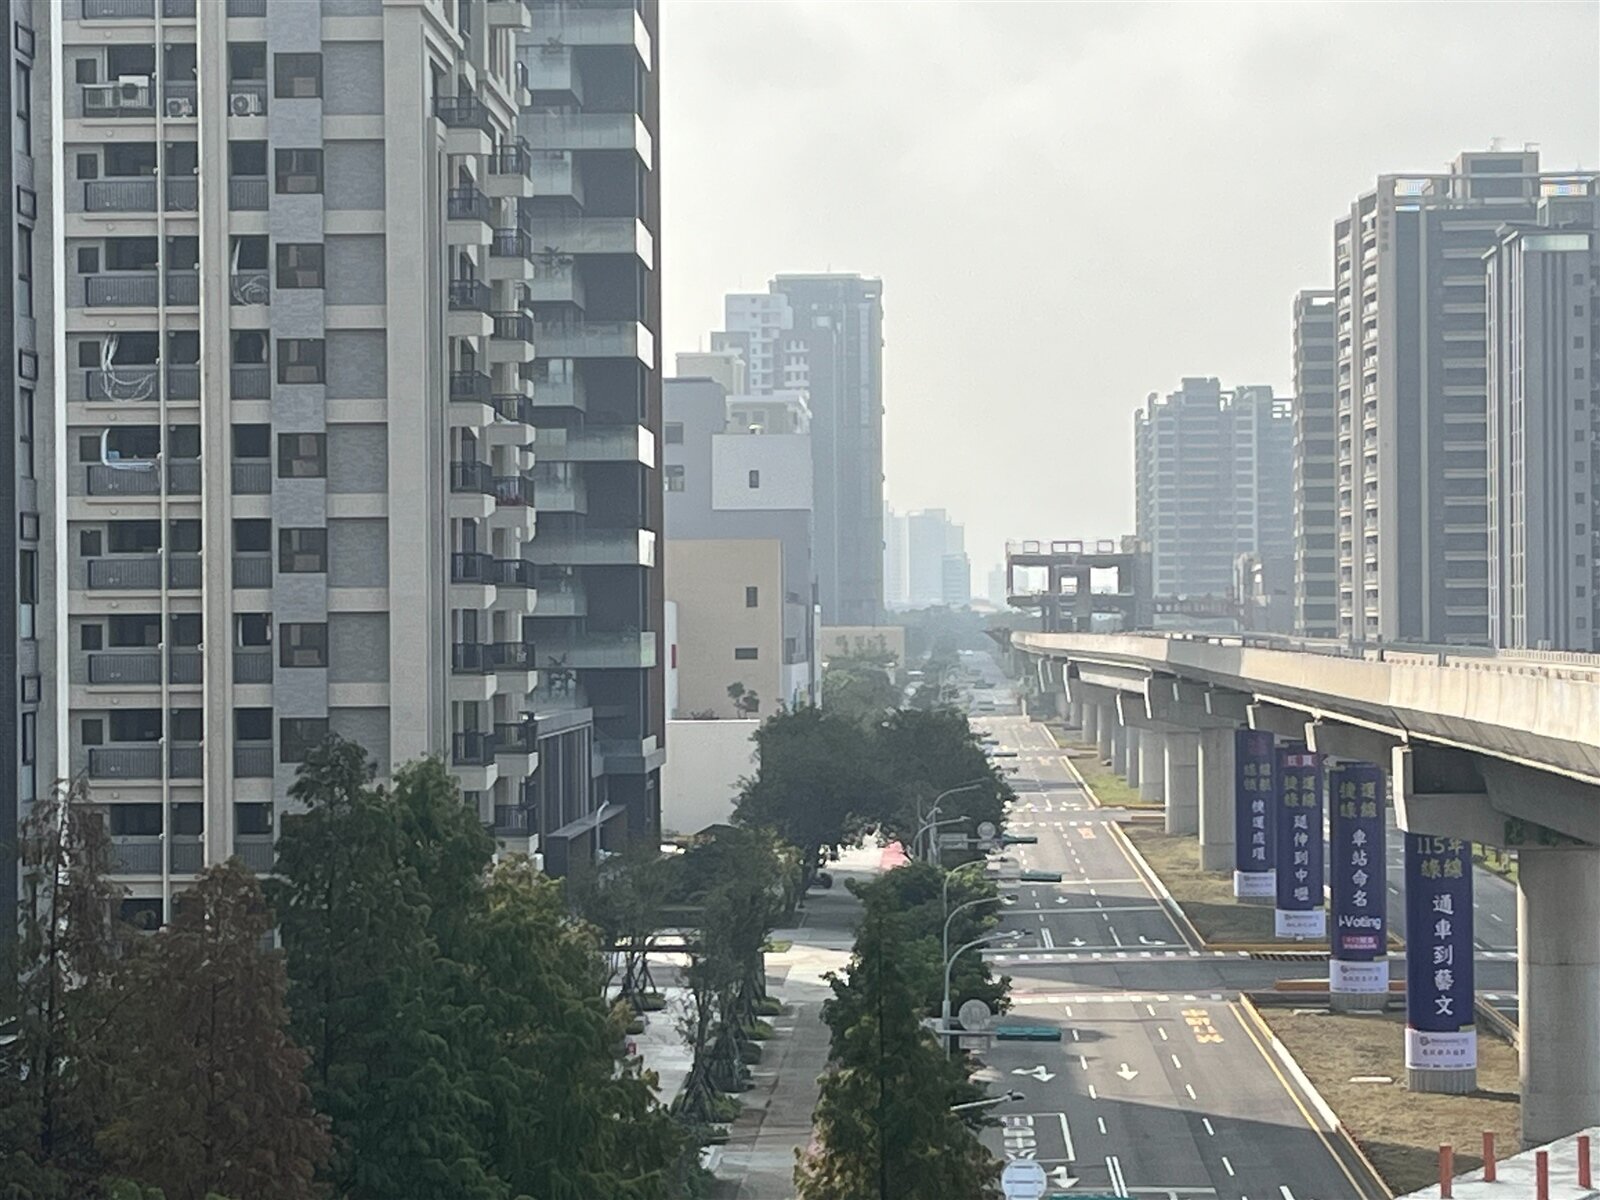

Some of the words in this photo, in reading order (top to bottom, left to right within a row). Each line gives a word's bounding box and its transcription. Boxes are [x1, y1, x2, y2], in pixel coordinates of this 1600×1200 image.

[1293, 814, 1309, 902] 延伸到中壢
[1351, 829, 1368, 907] 車站命名
[1416, 836, 1465, 855] 115年
[1421, 857, 1463, 880] 綠線
[1432, 893, 1455, 1016] 通車到藝文
